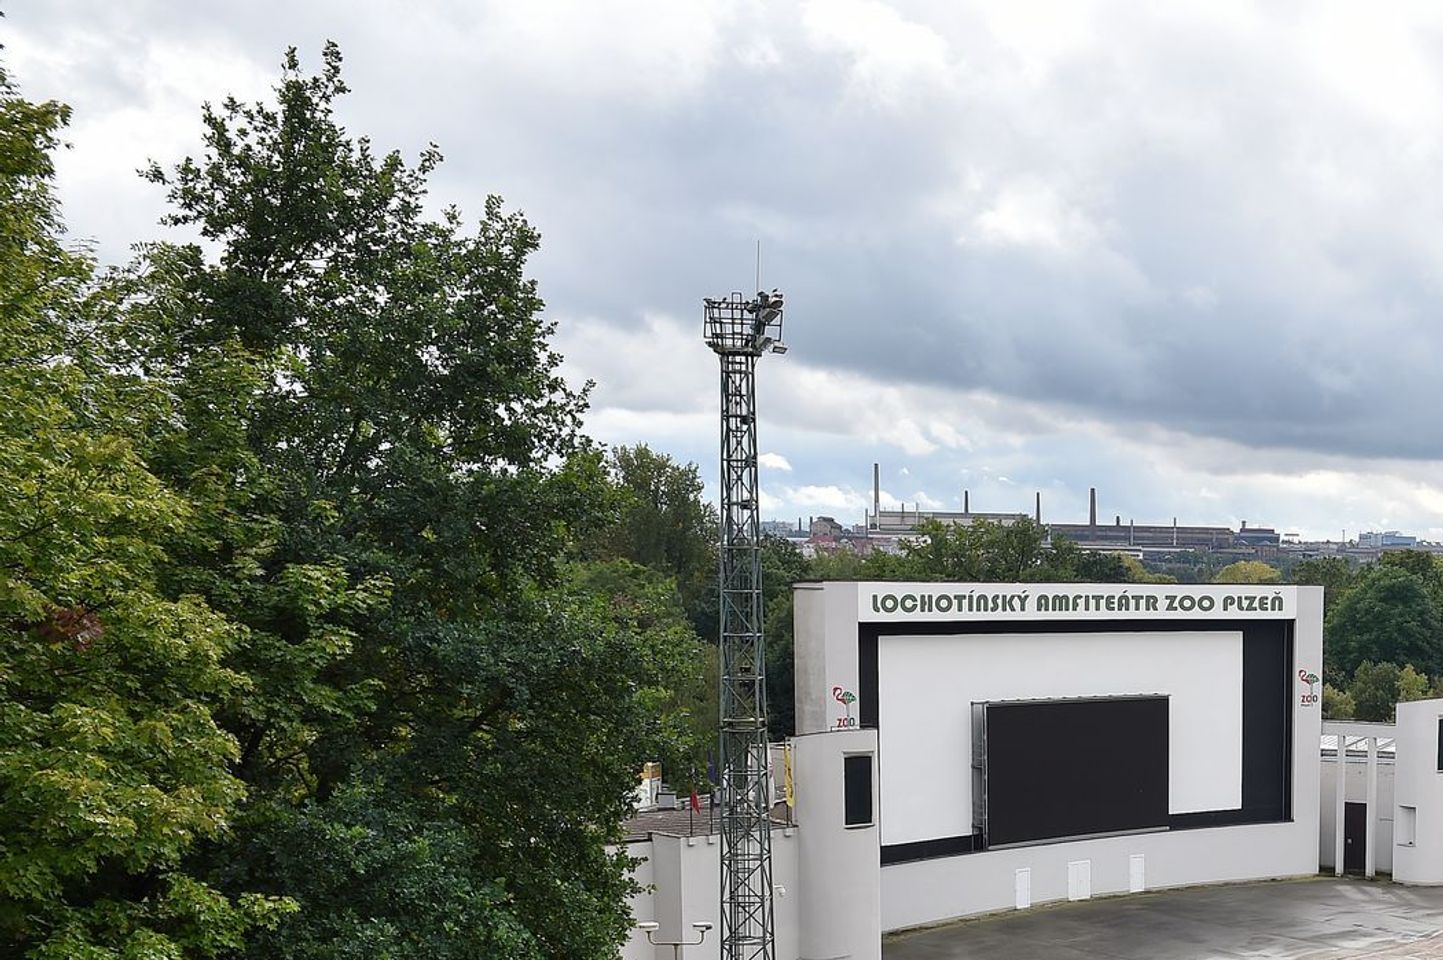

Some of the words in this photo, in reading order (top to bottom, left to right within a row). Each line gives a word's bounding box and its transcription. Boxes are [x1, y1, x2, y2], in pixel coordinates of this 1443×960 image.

[872, 589, 1029, 613] LOCHOTÍNSKÝ
[1036, 590, 1159, 612] AMFITEÁTR
[1165, 594, 1215, 612] ZOO
[1222, 591, 1284, 611] PLZEŇ
[1301, 695, 1318, 703] ZOO
[836, 717, 855, 728] ZOO
